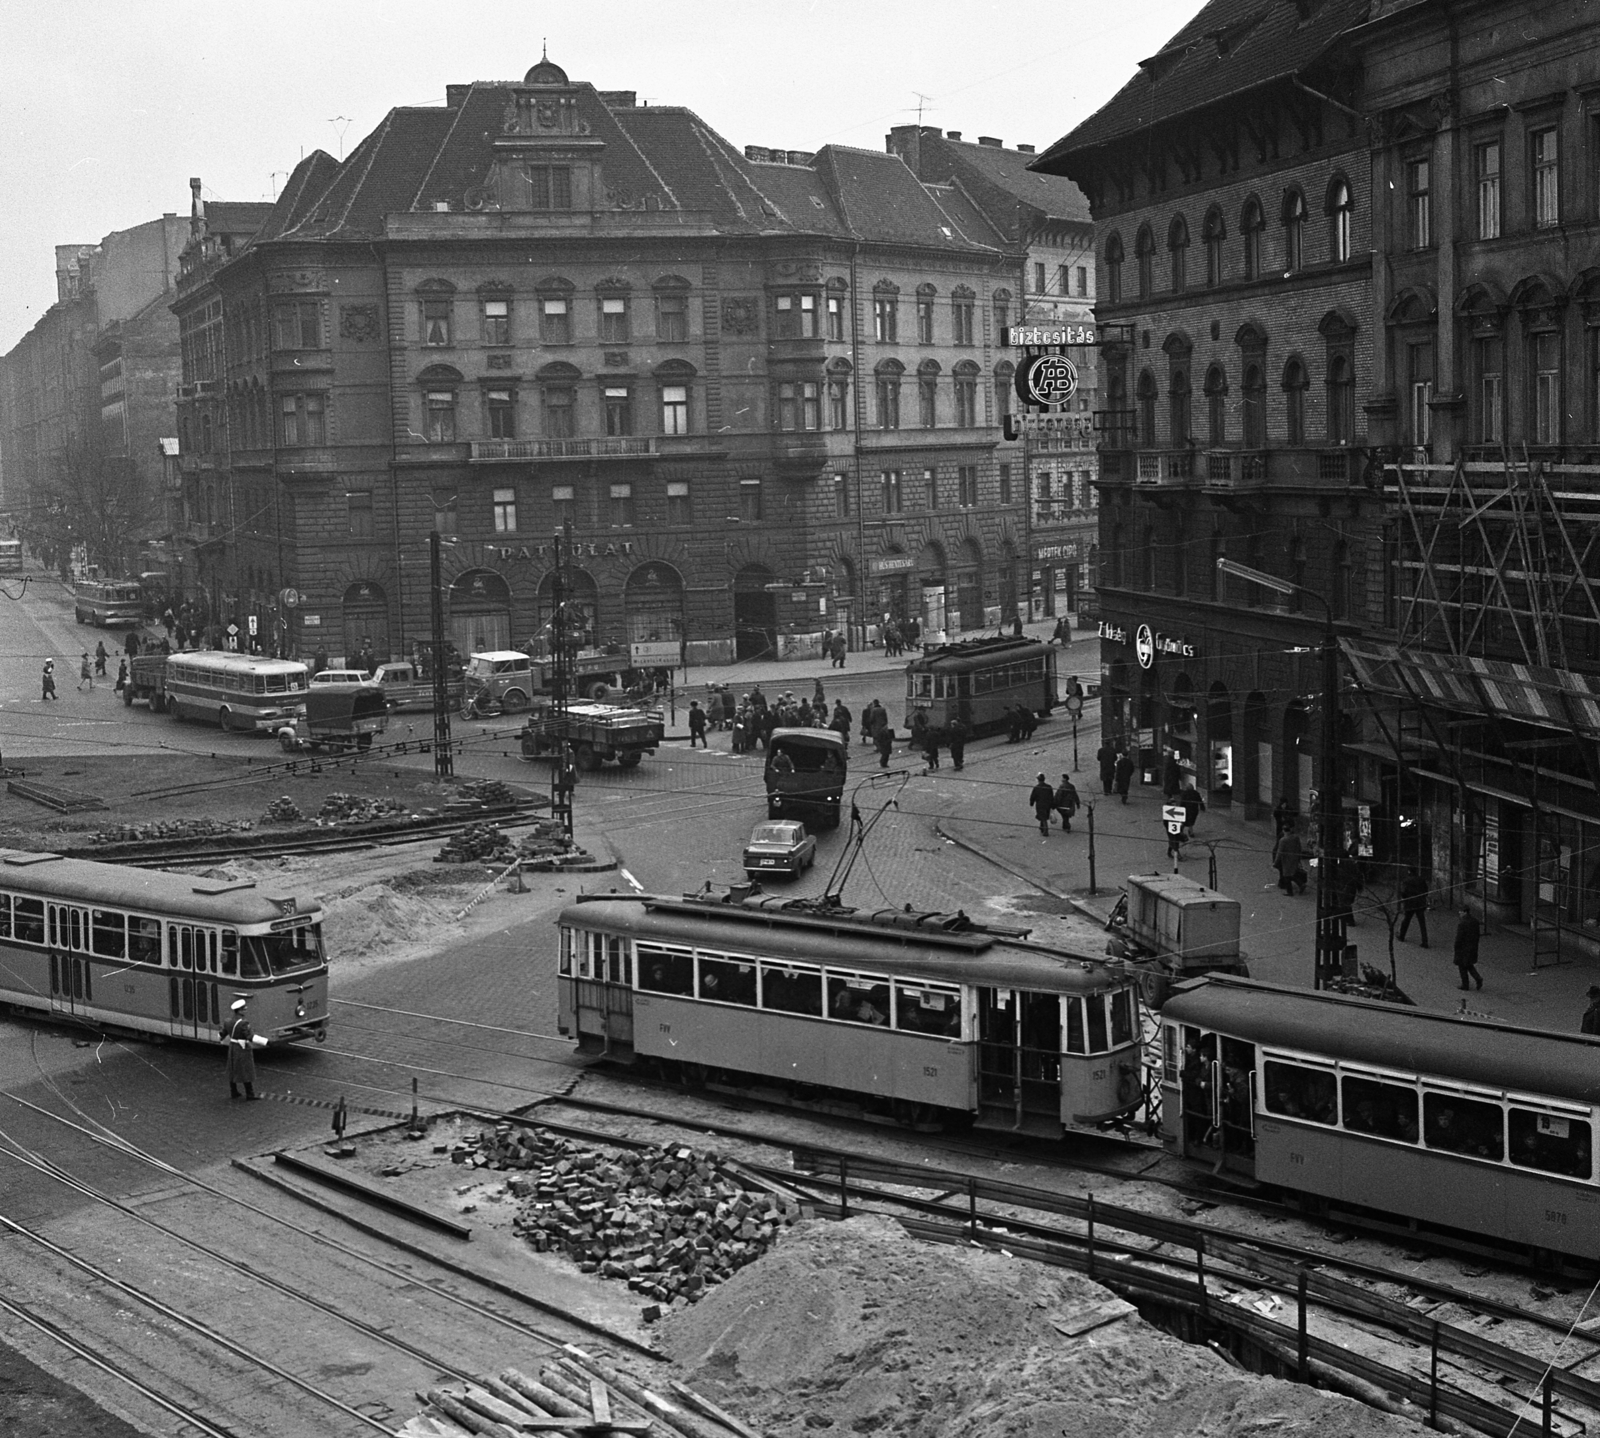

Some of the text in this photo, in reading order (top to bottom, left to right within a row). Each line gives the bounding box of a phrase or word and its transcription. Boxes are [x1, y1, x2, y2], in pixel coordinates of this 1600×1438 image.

[1171, 823, 1178, 832] 3
[659, 1023, 671, 1034] FVV
[923, 1066, 938, 1077] 1521
[1092, 1069, 1106, 1081] 1521
